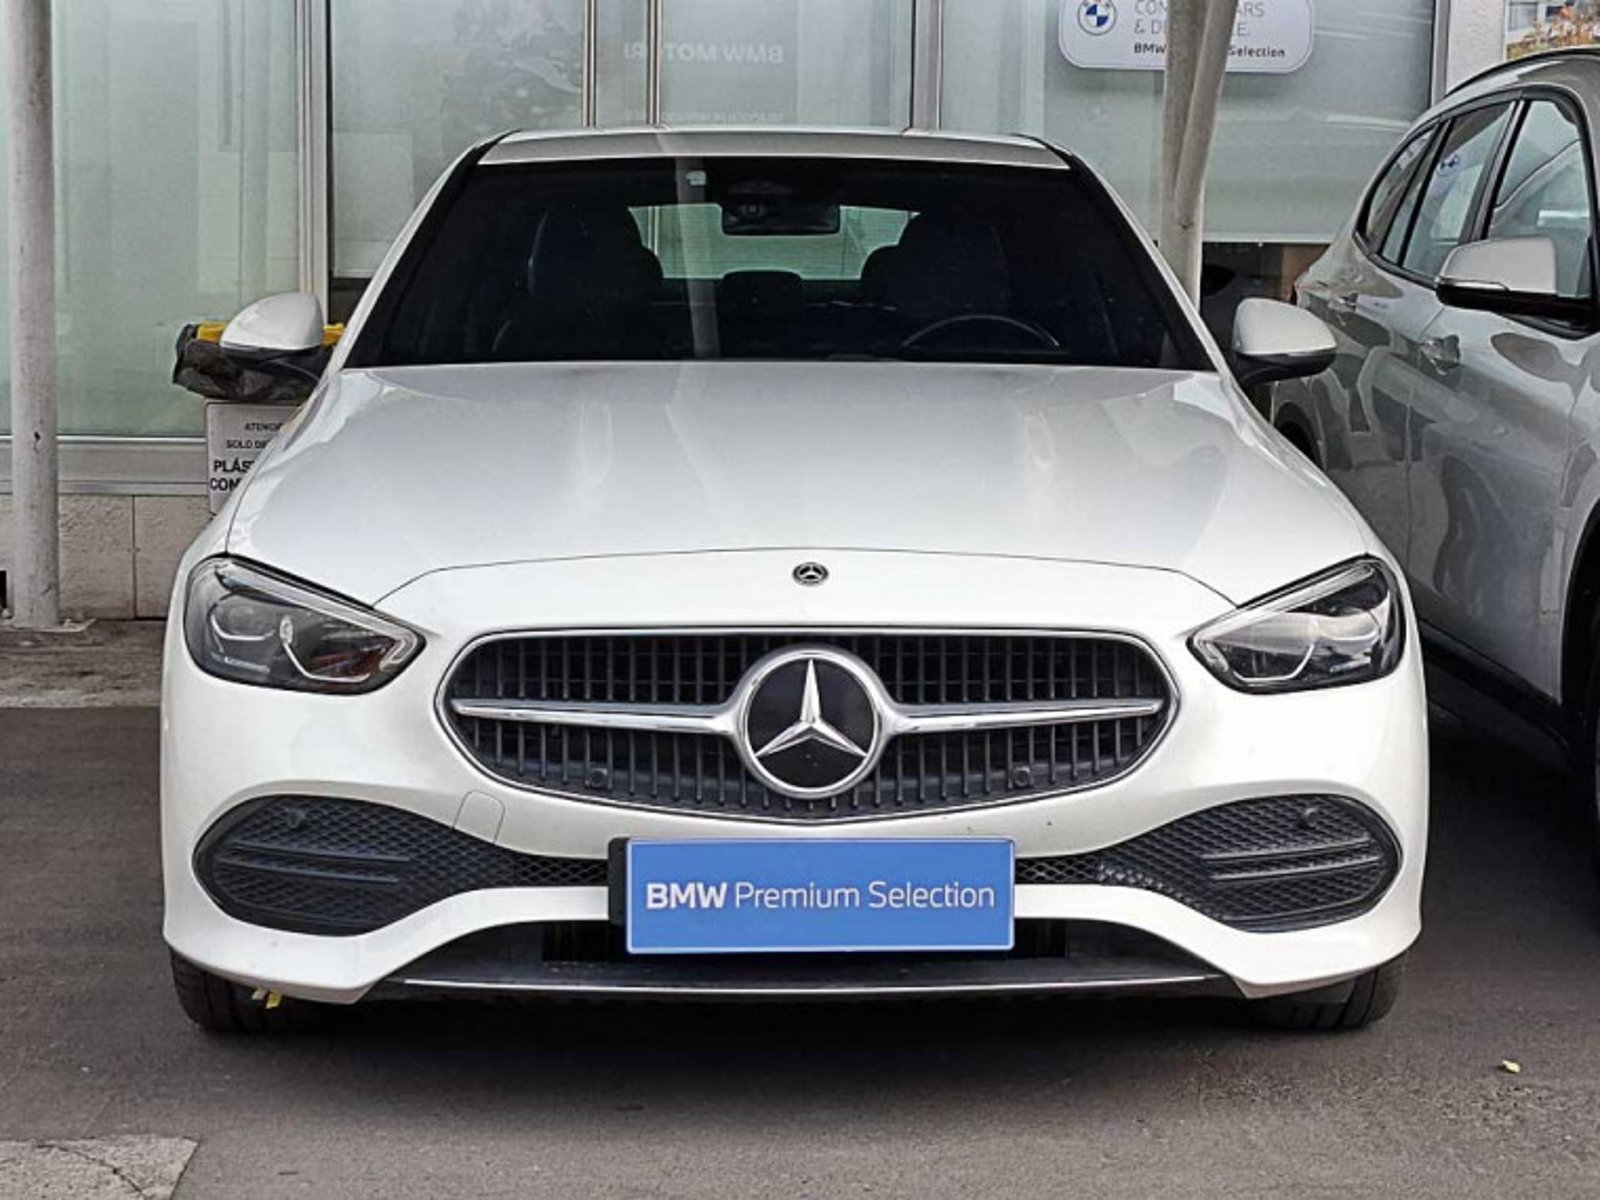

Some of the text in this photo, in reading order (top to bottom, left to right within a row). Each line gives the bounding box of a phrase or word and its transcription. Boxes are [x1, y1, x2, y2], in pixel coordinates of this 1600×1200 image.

[1134, 42, 1167, 54] BMW
[645, 881, 995, 910] BMW Premium Selection
